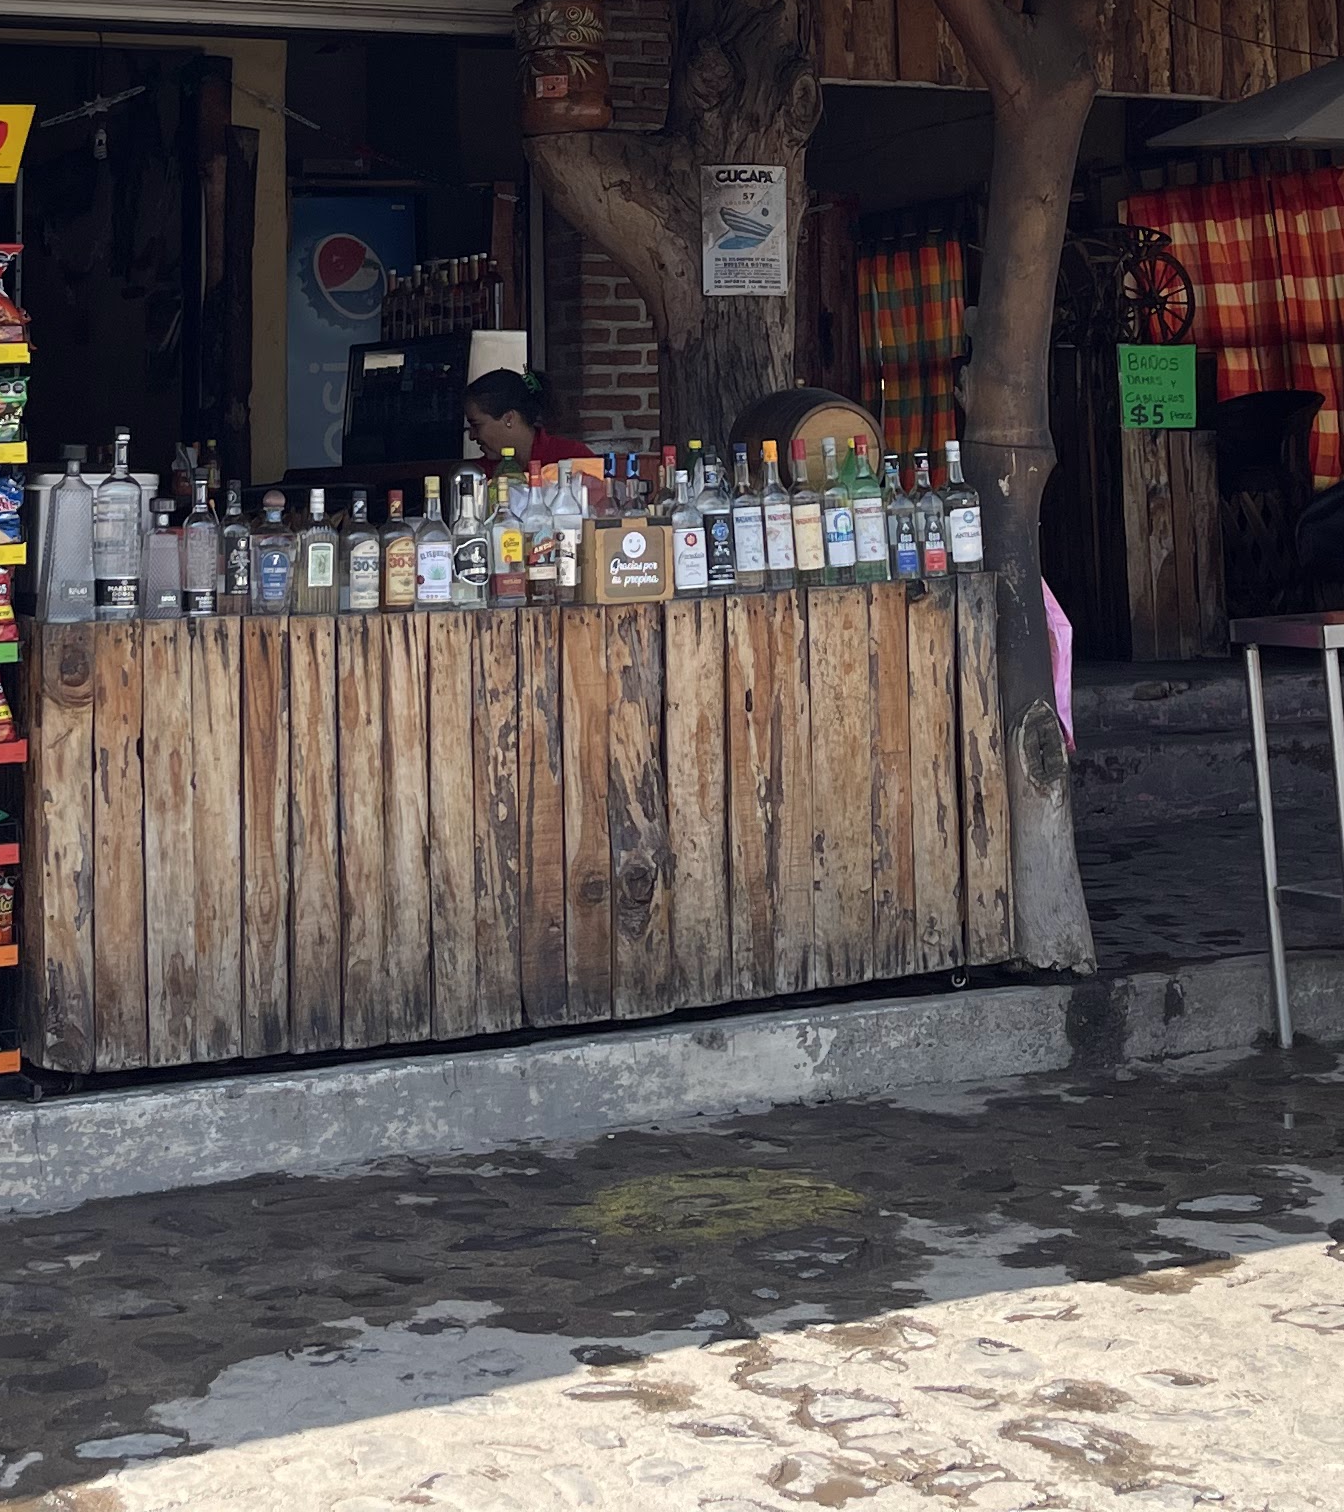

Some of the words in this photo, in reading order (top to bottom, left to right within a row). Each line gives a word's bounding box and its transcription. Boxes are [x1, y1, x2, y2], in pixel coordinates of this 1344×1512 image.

[388, 557, 415, 568] 30-3
[610, 558, 642, 575] Gracias
[642, 561, 658, 573] por
[623, 572, 659, 587] propina
